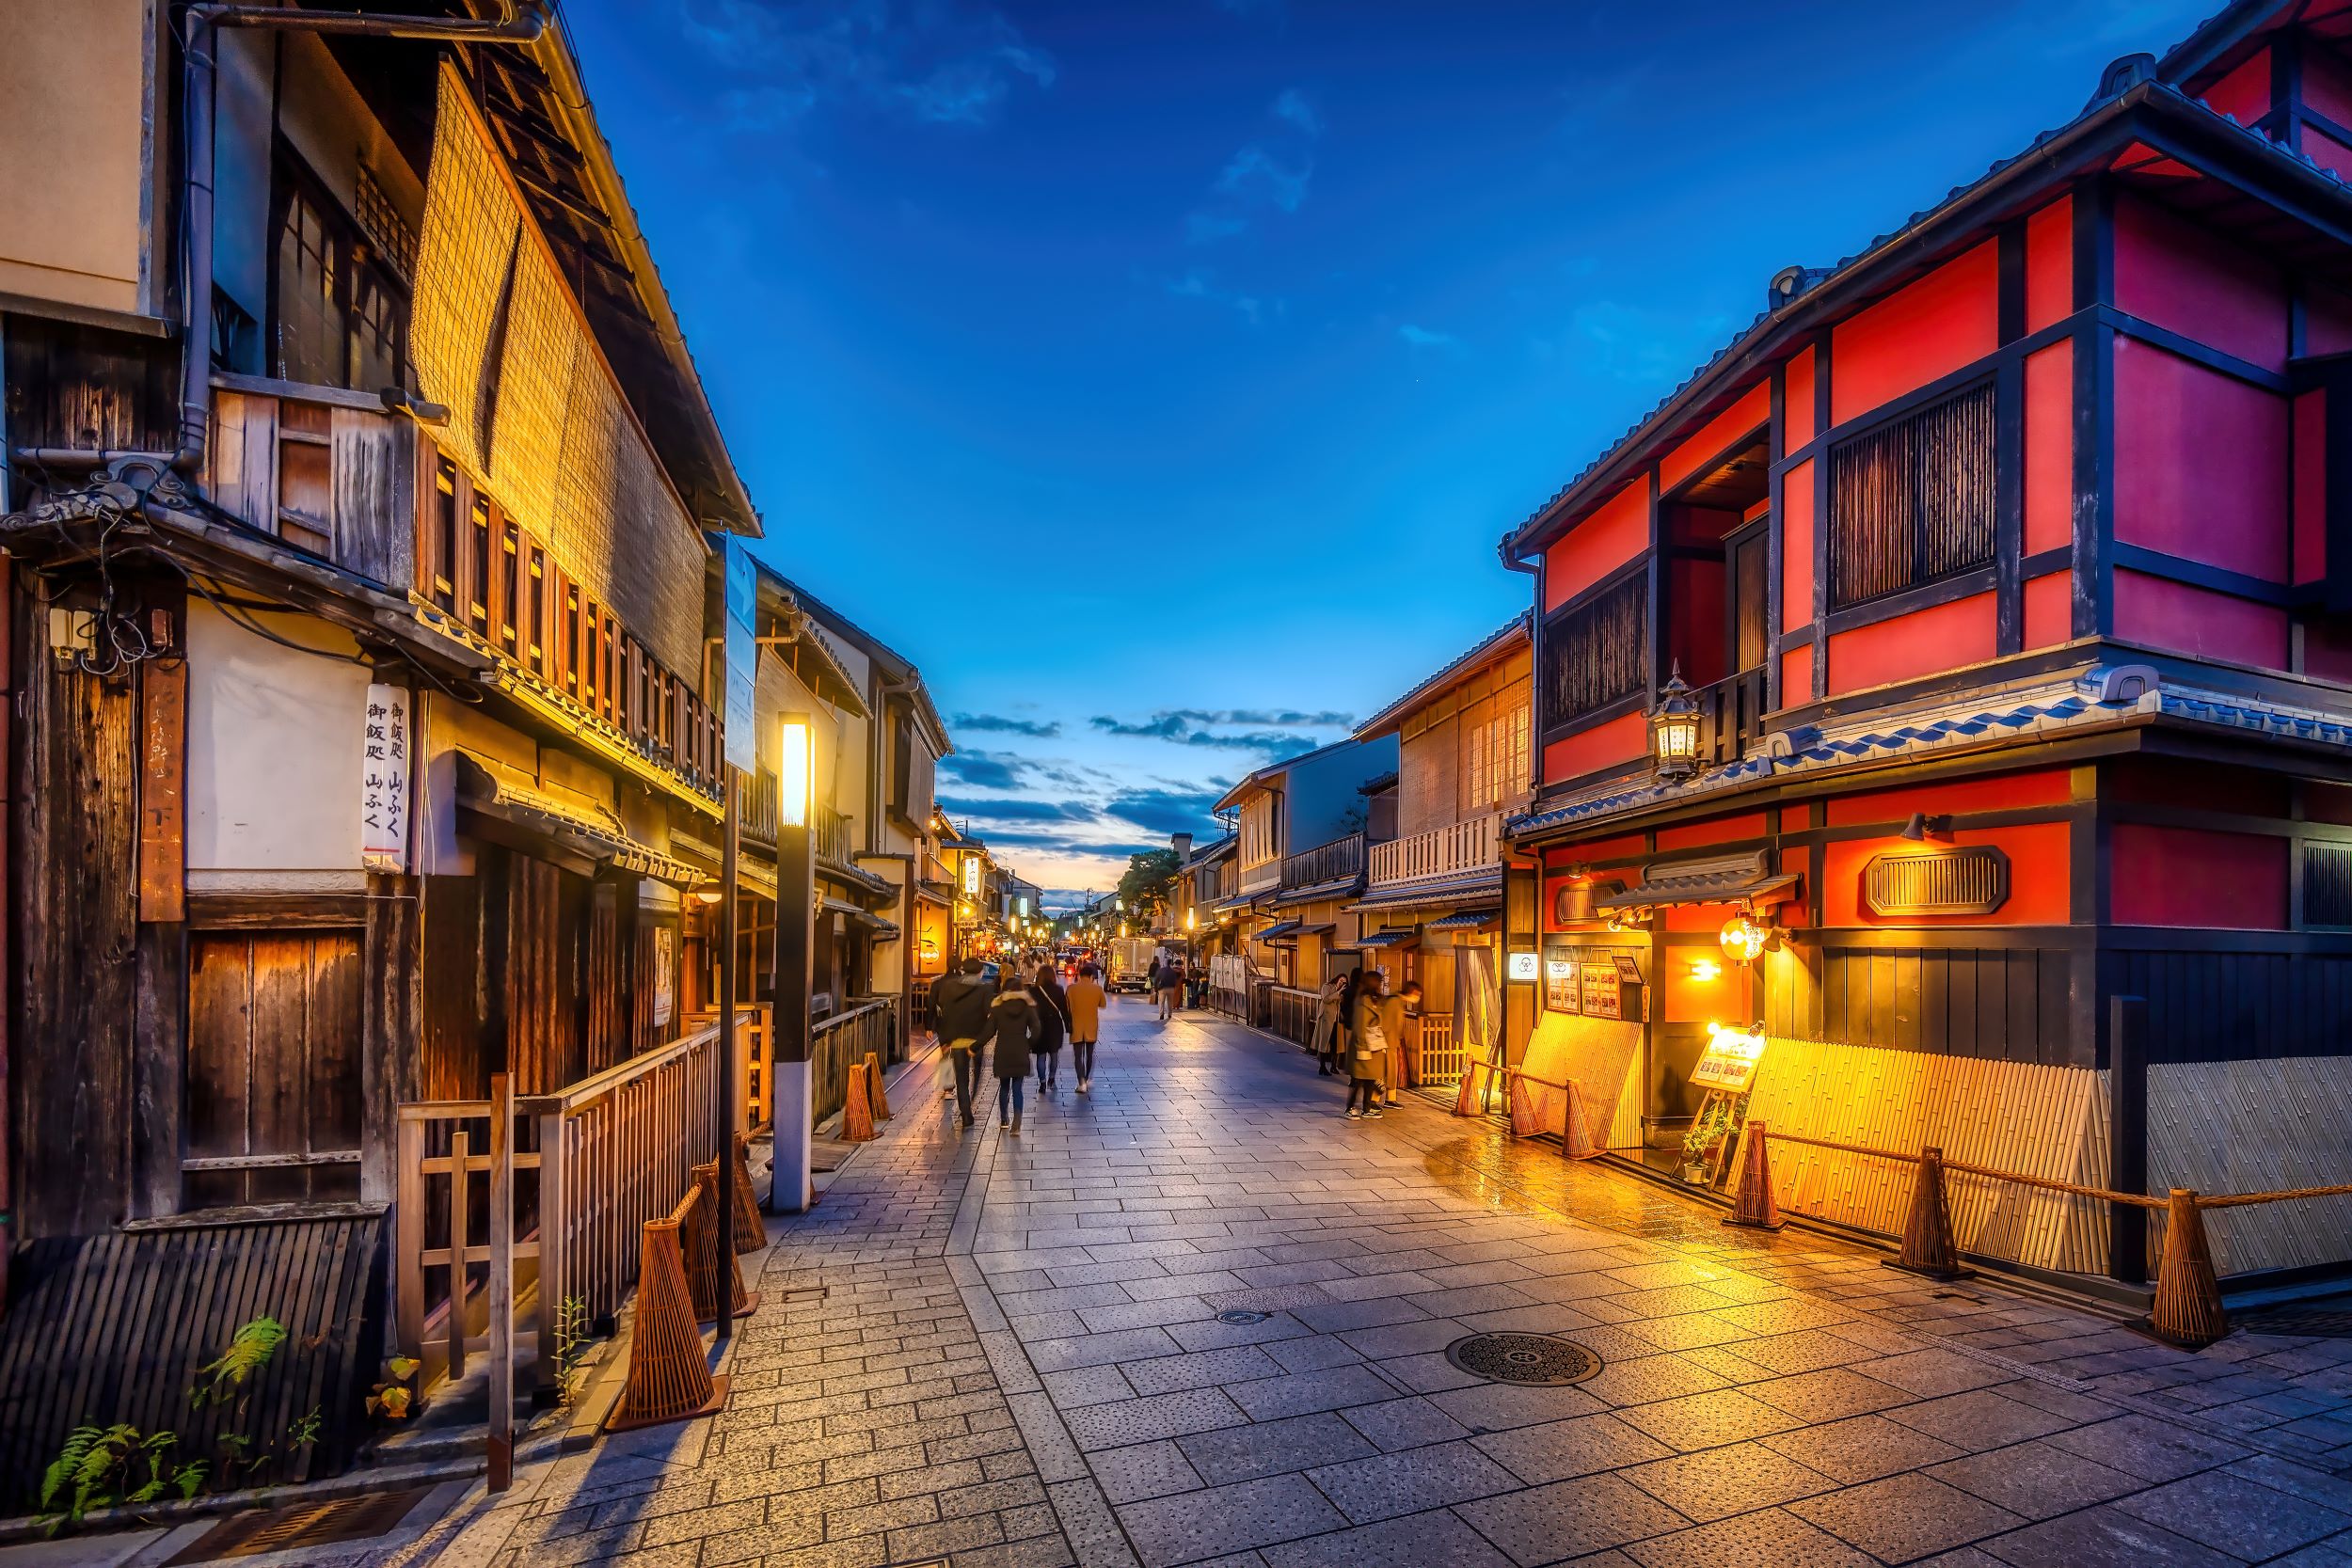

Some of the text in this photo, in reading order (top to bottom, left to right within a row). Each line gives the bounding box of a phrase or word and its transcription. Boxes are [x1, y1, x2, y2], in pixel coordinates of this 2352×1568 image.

[365, 703, 387, 829] 御飯処 山ふく
[388, 702, 404, 838] 御飯処 山ふく
